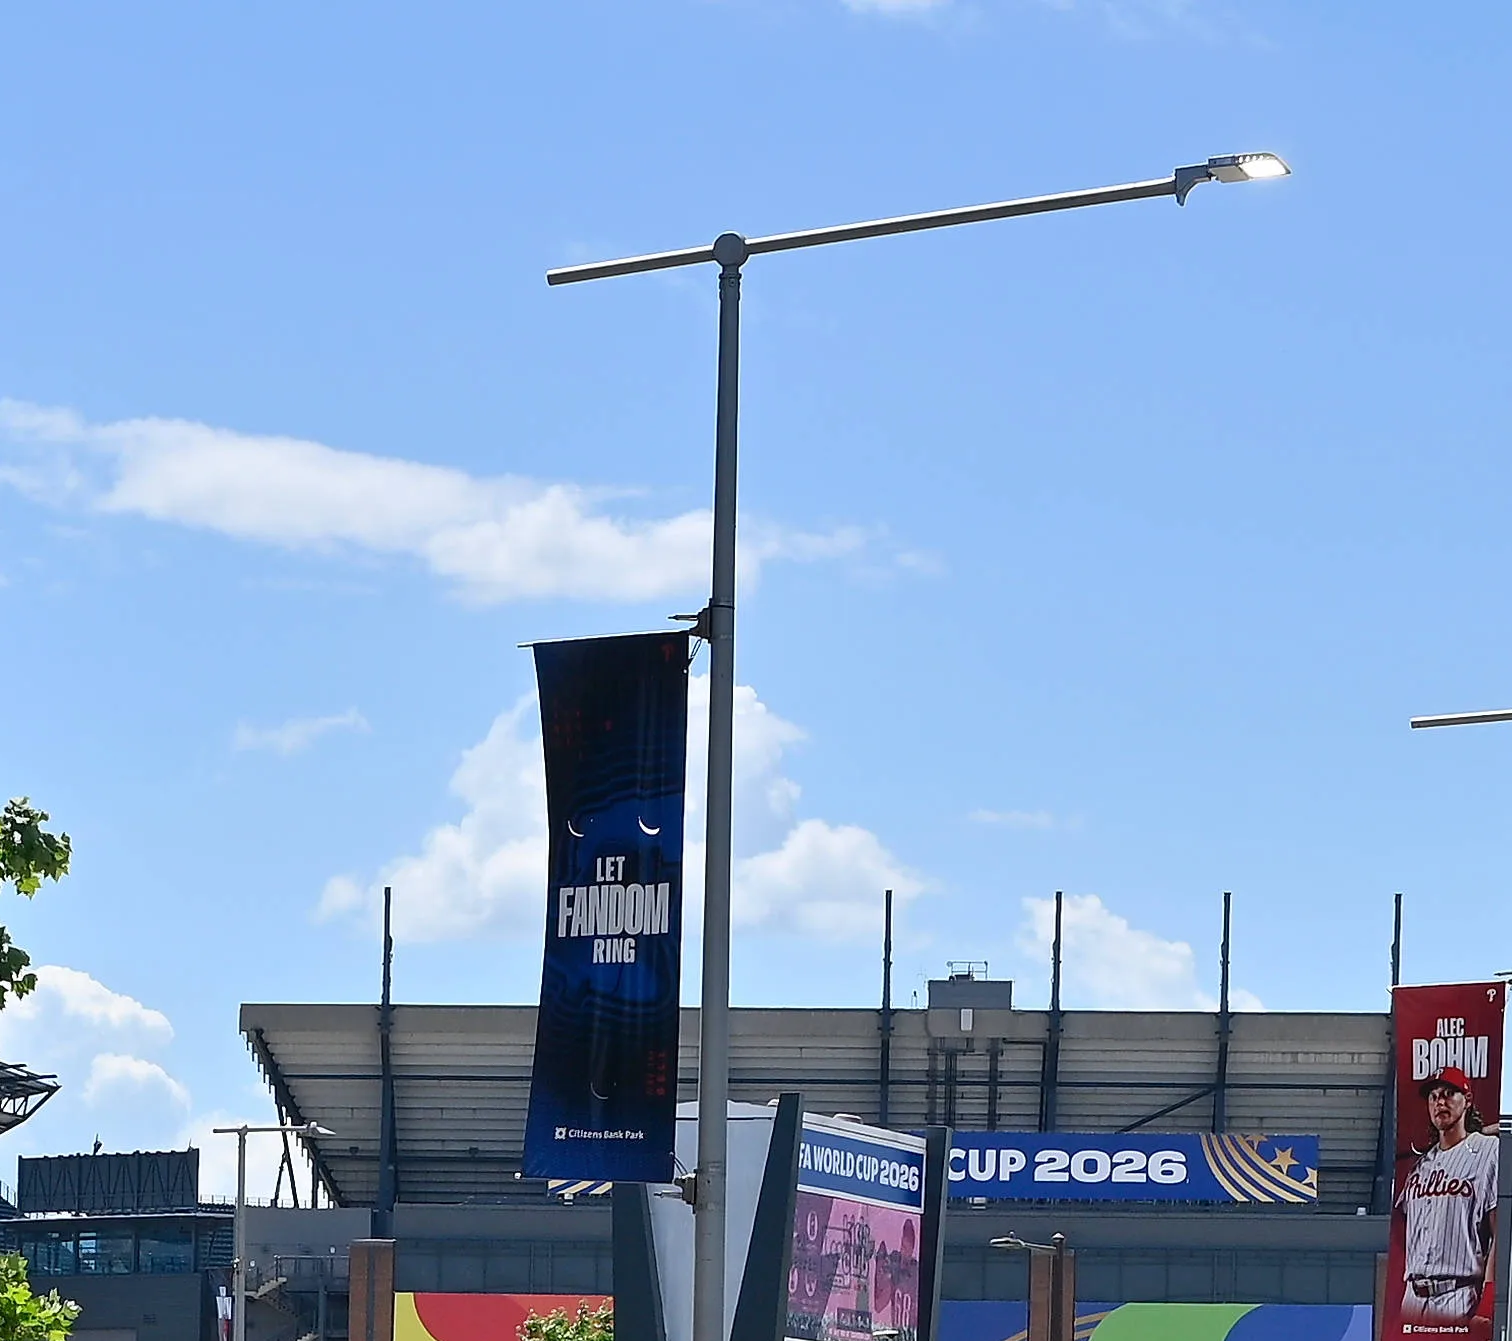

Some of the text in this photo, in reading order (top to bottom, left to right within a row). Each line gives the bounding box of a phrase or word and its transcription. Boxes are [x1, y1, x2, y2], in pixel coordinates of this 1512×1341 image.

[596, 856, 626, 882] LET
[558, 882, 670, 938] FANDOM
[592, 937, 636, 964] RING
[1436, 1017, 1465, 1037] ALEC
[1412, 1036, 1489, 1081] BOHM
[568, 1129, 644, 1139] Citizens Bank Park
[813, 1145, 855, 1178] WORLD
[856, 1154, 879, 1183] CUP
[879, 1159, 920, 1192] 2026
[948, 1148, 1188, 1184] CUP 2026
[1408, 1169, 1473, 1199] Phillies
